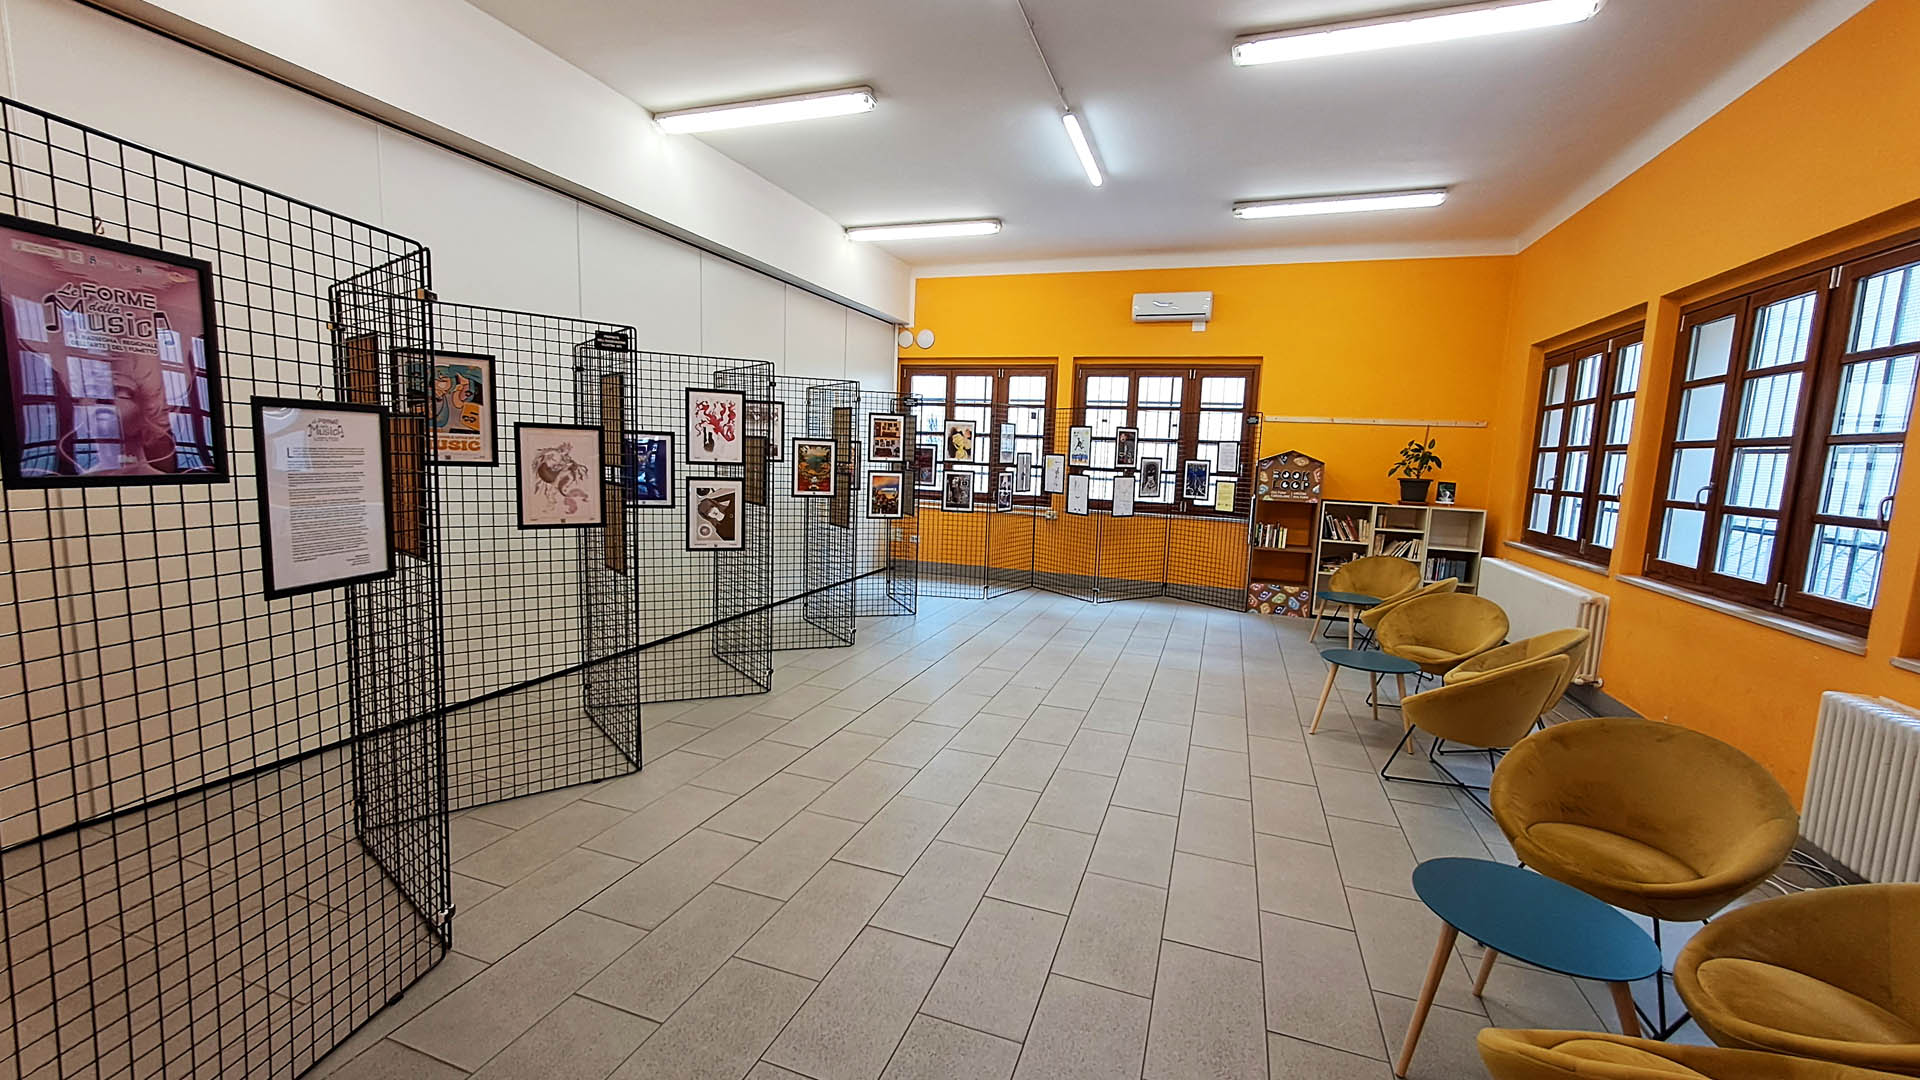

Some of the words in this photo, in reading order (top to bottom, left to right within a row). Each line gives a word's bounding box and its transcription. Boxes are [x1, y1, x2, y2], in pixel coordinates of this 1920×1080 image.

[58, 284, 79, 296] Le
[82, 284, 155, 309] FORME
[89, 302, 121, 314] della
[1272, 470, 1309, 481] BOOK
[1272, 480, 1310, 490] LOOP
